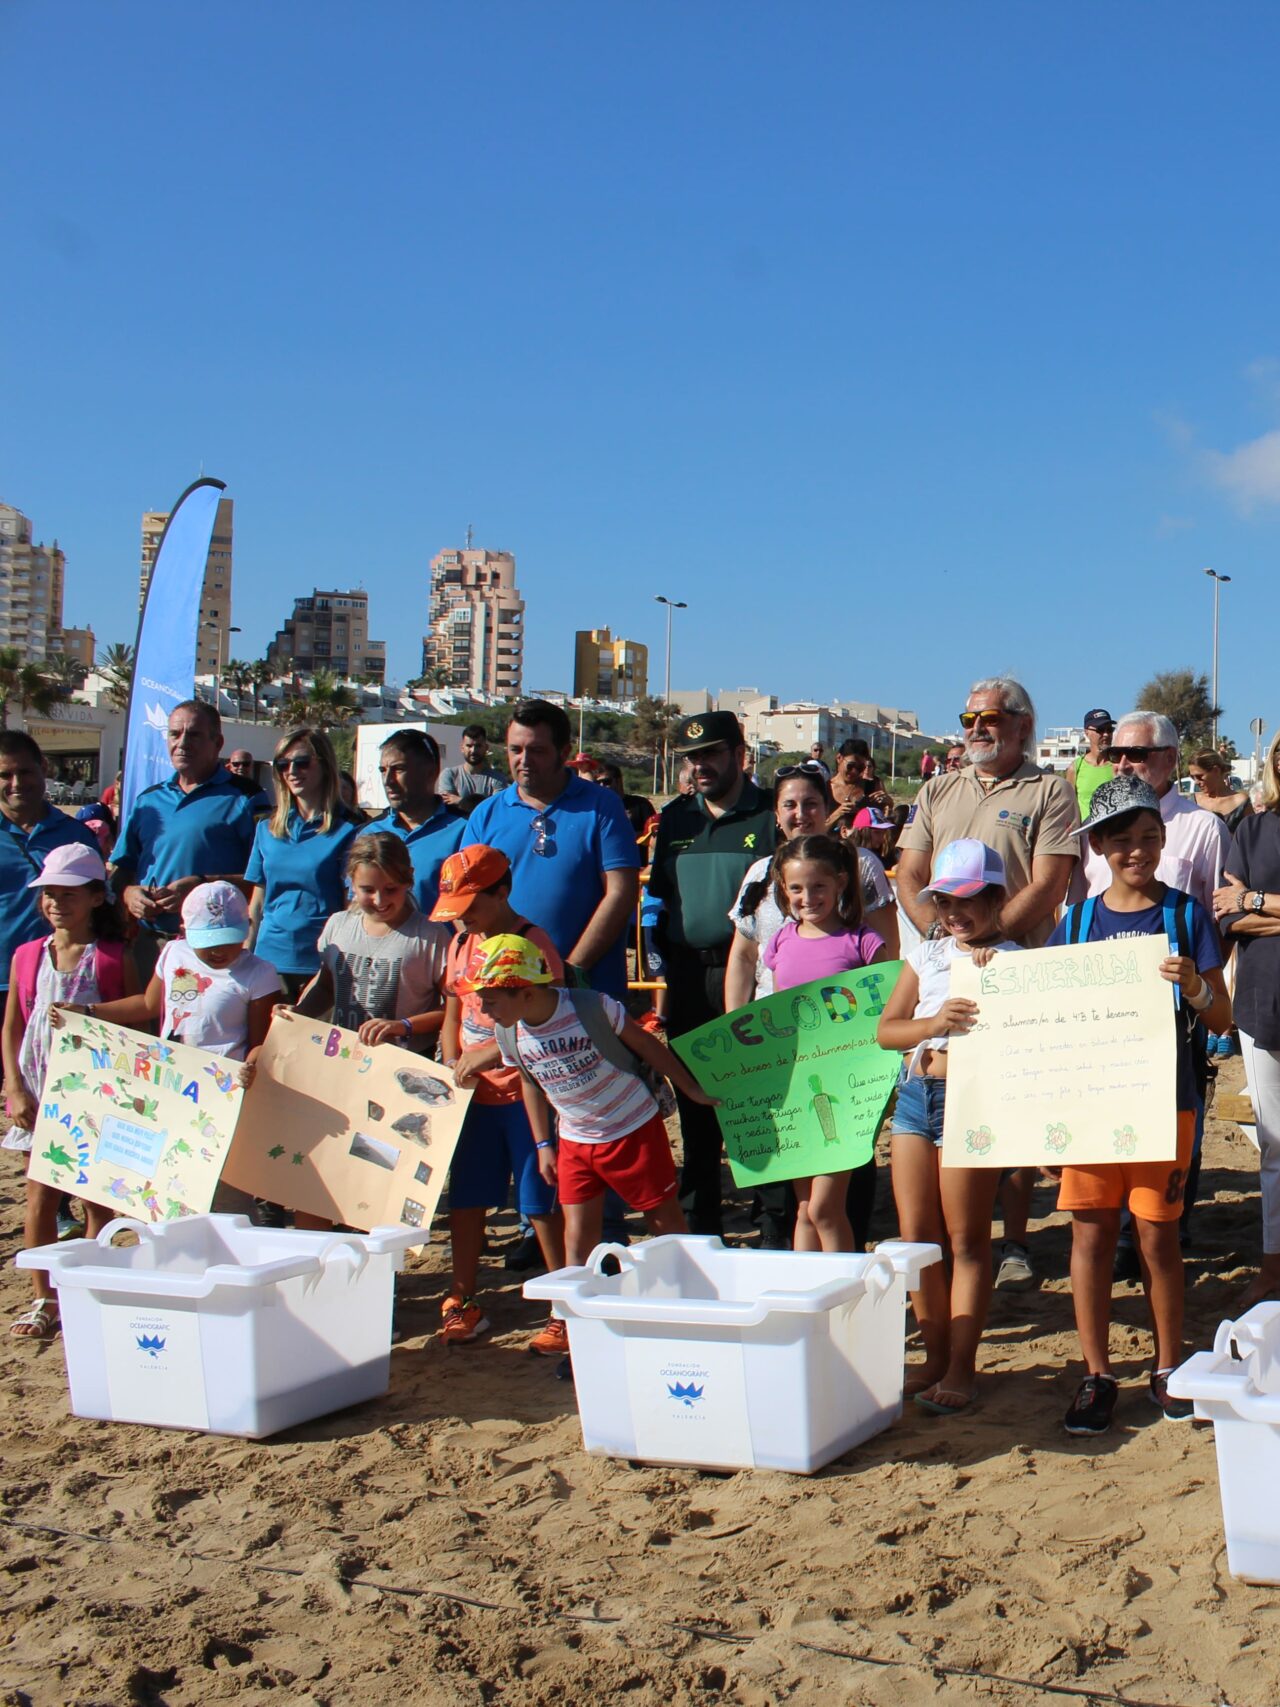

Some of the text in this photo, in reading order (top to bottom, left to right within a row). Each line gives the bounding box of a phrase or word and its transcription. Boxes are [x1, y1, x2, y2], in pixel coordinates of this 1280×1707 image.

[980, 951, 1142, 995] ESMERALDA
[1054, 1012, 1067, 1025] de
[1092, 1009, 1100, 1021] te
[1106, 1006, 1139, 1020] deseamos
[567, 1051, 598, 1075] BEACH
[711, 1070, 737, 1083] Los
[740, 1062, 773, 1076] deseos
[776, 1055, 790, 1067] de
[793, 1049, 810, 1063] los
[91, 1048, 200, 1104] MARINA
[560, 1081, 581, 1093] GOLDEN
[582, 1070, 598, 1085] STATE
[846, 1072, 866, 1089] Que
[726, 1093, 783, 1111] Que tengas
[850, 1095, 863, 1106] tu
[864, 1091, 882, 1103] vida
[725, 1106, 802, 1126] muchas tortugas
[853, 1113, 864, 1121] no
[867, 1109, 875, 1118] te
[43, 1103, 90, 1185] MARINA
[733, 1132, 741, 1143] y
[774, 1124, 796, 1133] una
[737, 1137, 801, 1163] familia feliz
